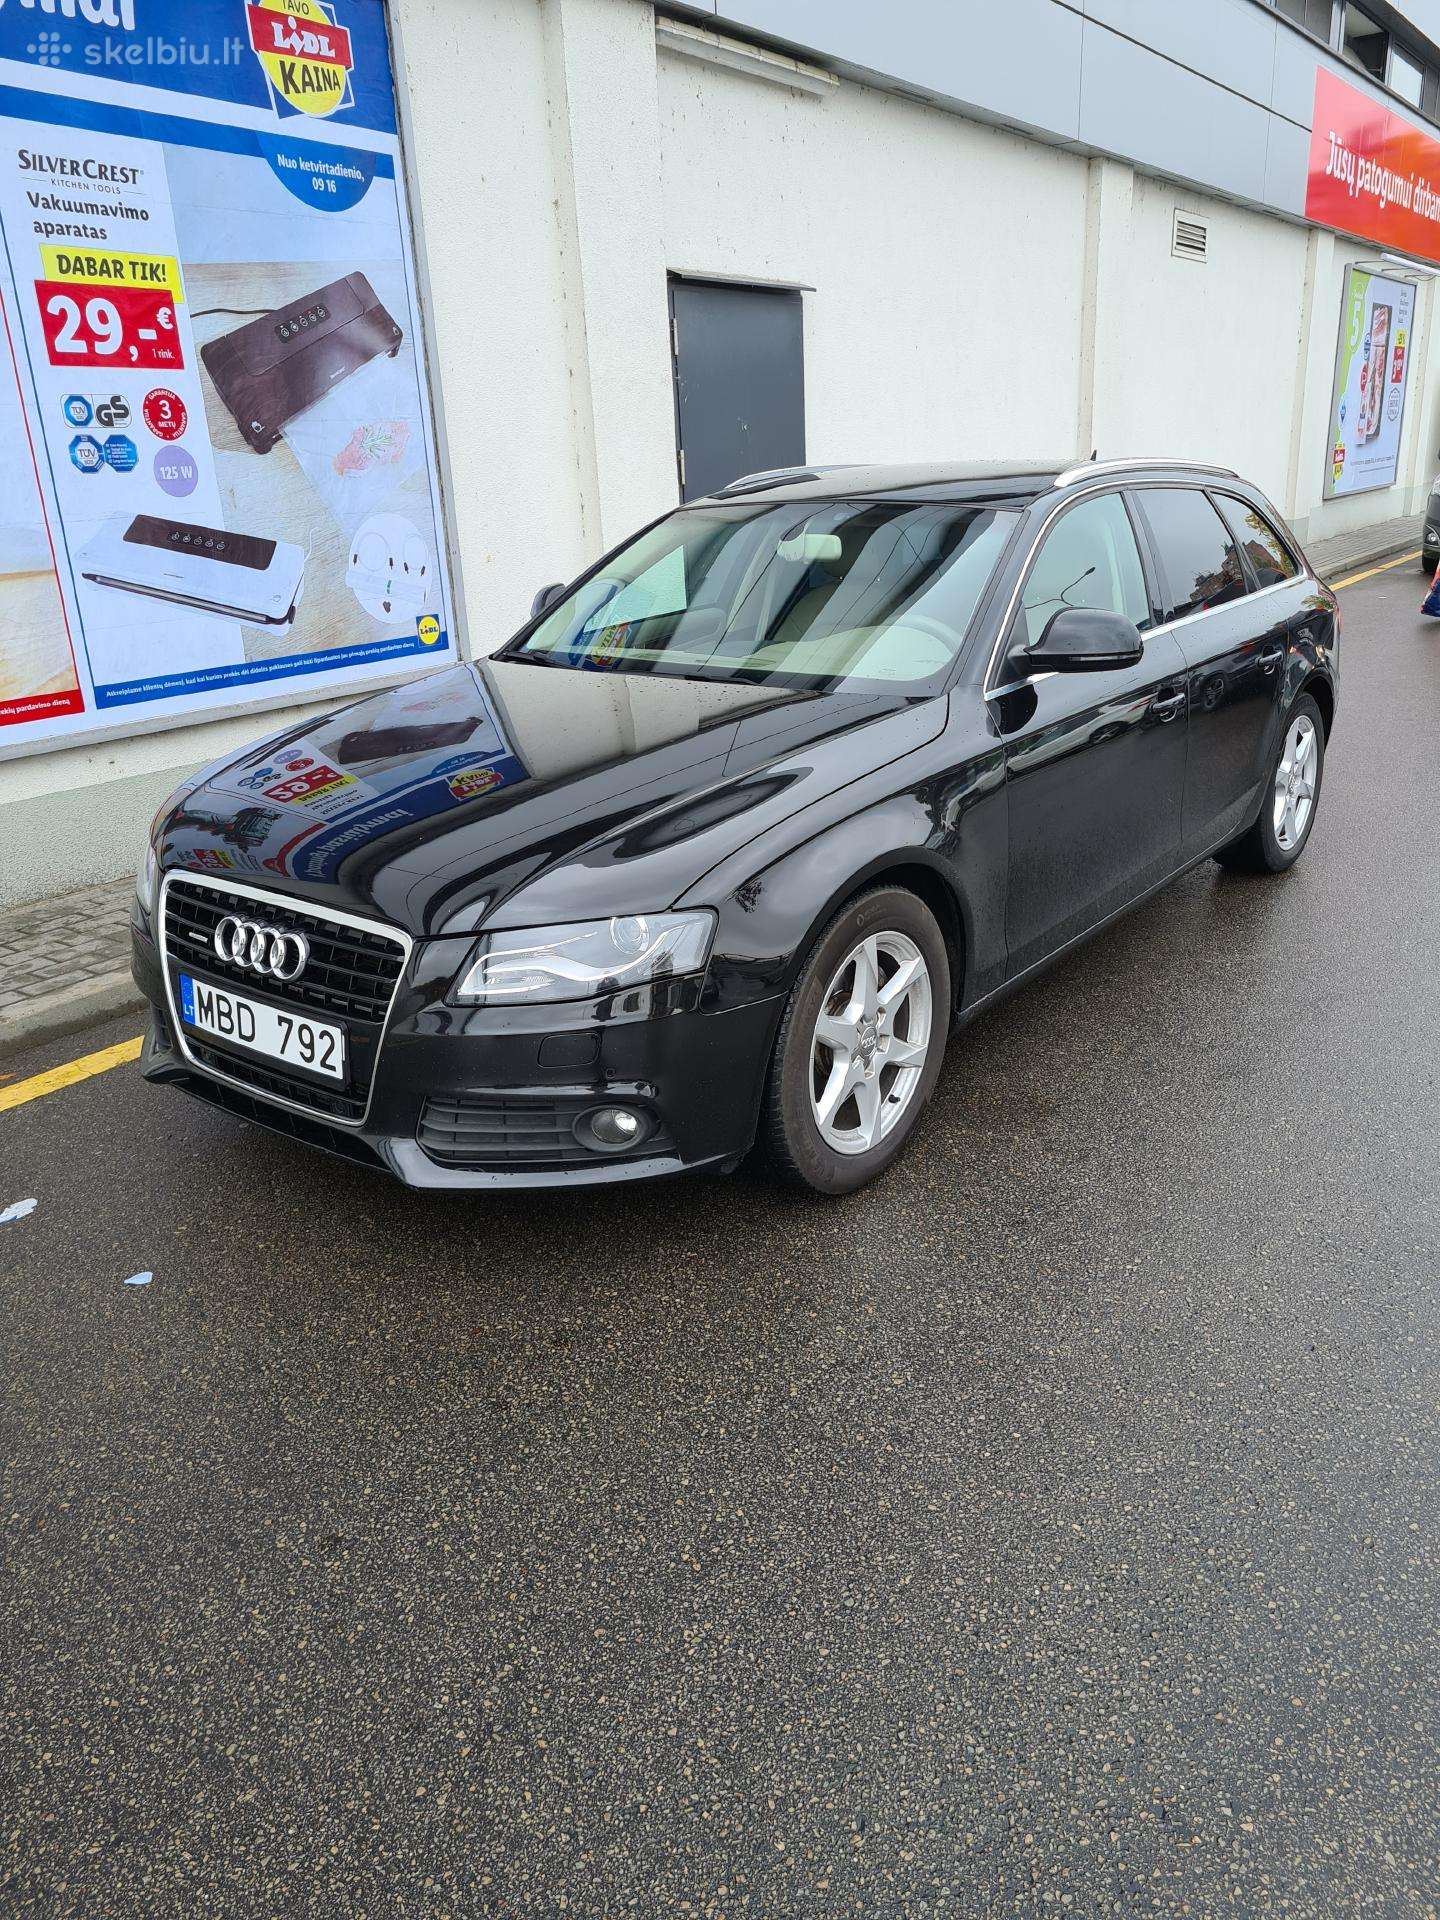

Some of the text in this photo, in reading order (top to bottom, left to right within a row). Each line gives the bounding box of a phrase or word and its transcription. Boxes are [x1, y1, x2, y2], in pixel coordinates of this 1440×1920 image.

[279, 60, 341, 94] KAINA
[277, 153, 365, 183] Nuo ketvirtadienio,
[1325, 128, 1356, 196] Jūsų
[1355, 157, 1415, 209] patogumui
[51, 178, 121, 195] KITCHEN TOOLS
[311, 176, 337, 193] 09 16
[26, 190, 150, 222] Vakuumavimo
[33, 220, 108, 240] aparatas
[56, 254, 167, 283] DABAR TIK!
[151, 348, 175, 359] 1 rink.
[96, 395, 130, 427] GS
[158, 399, 172, 420] 3
[77, 448, 96, 458] TÜV
[160, 465, 193, 480] 125 W
[16, 701, 52, 714] pardavimo
[184, 1005, 194, 1017] LT
[197, 985, 337, 1072] MBD 792
